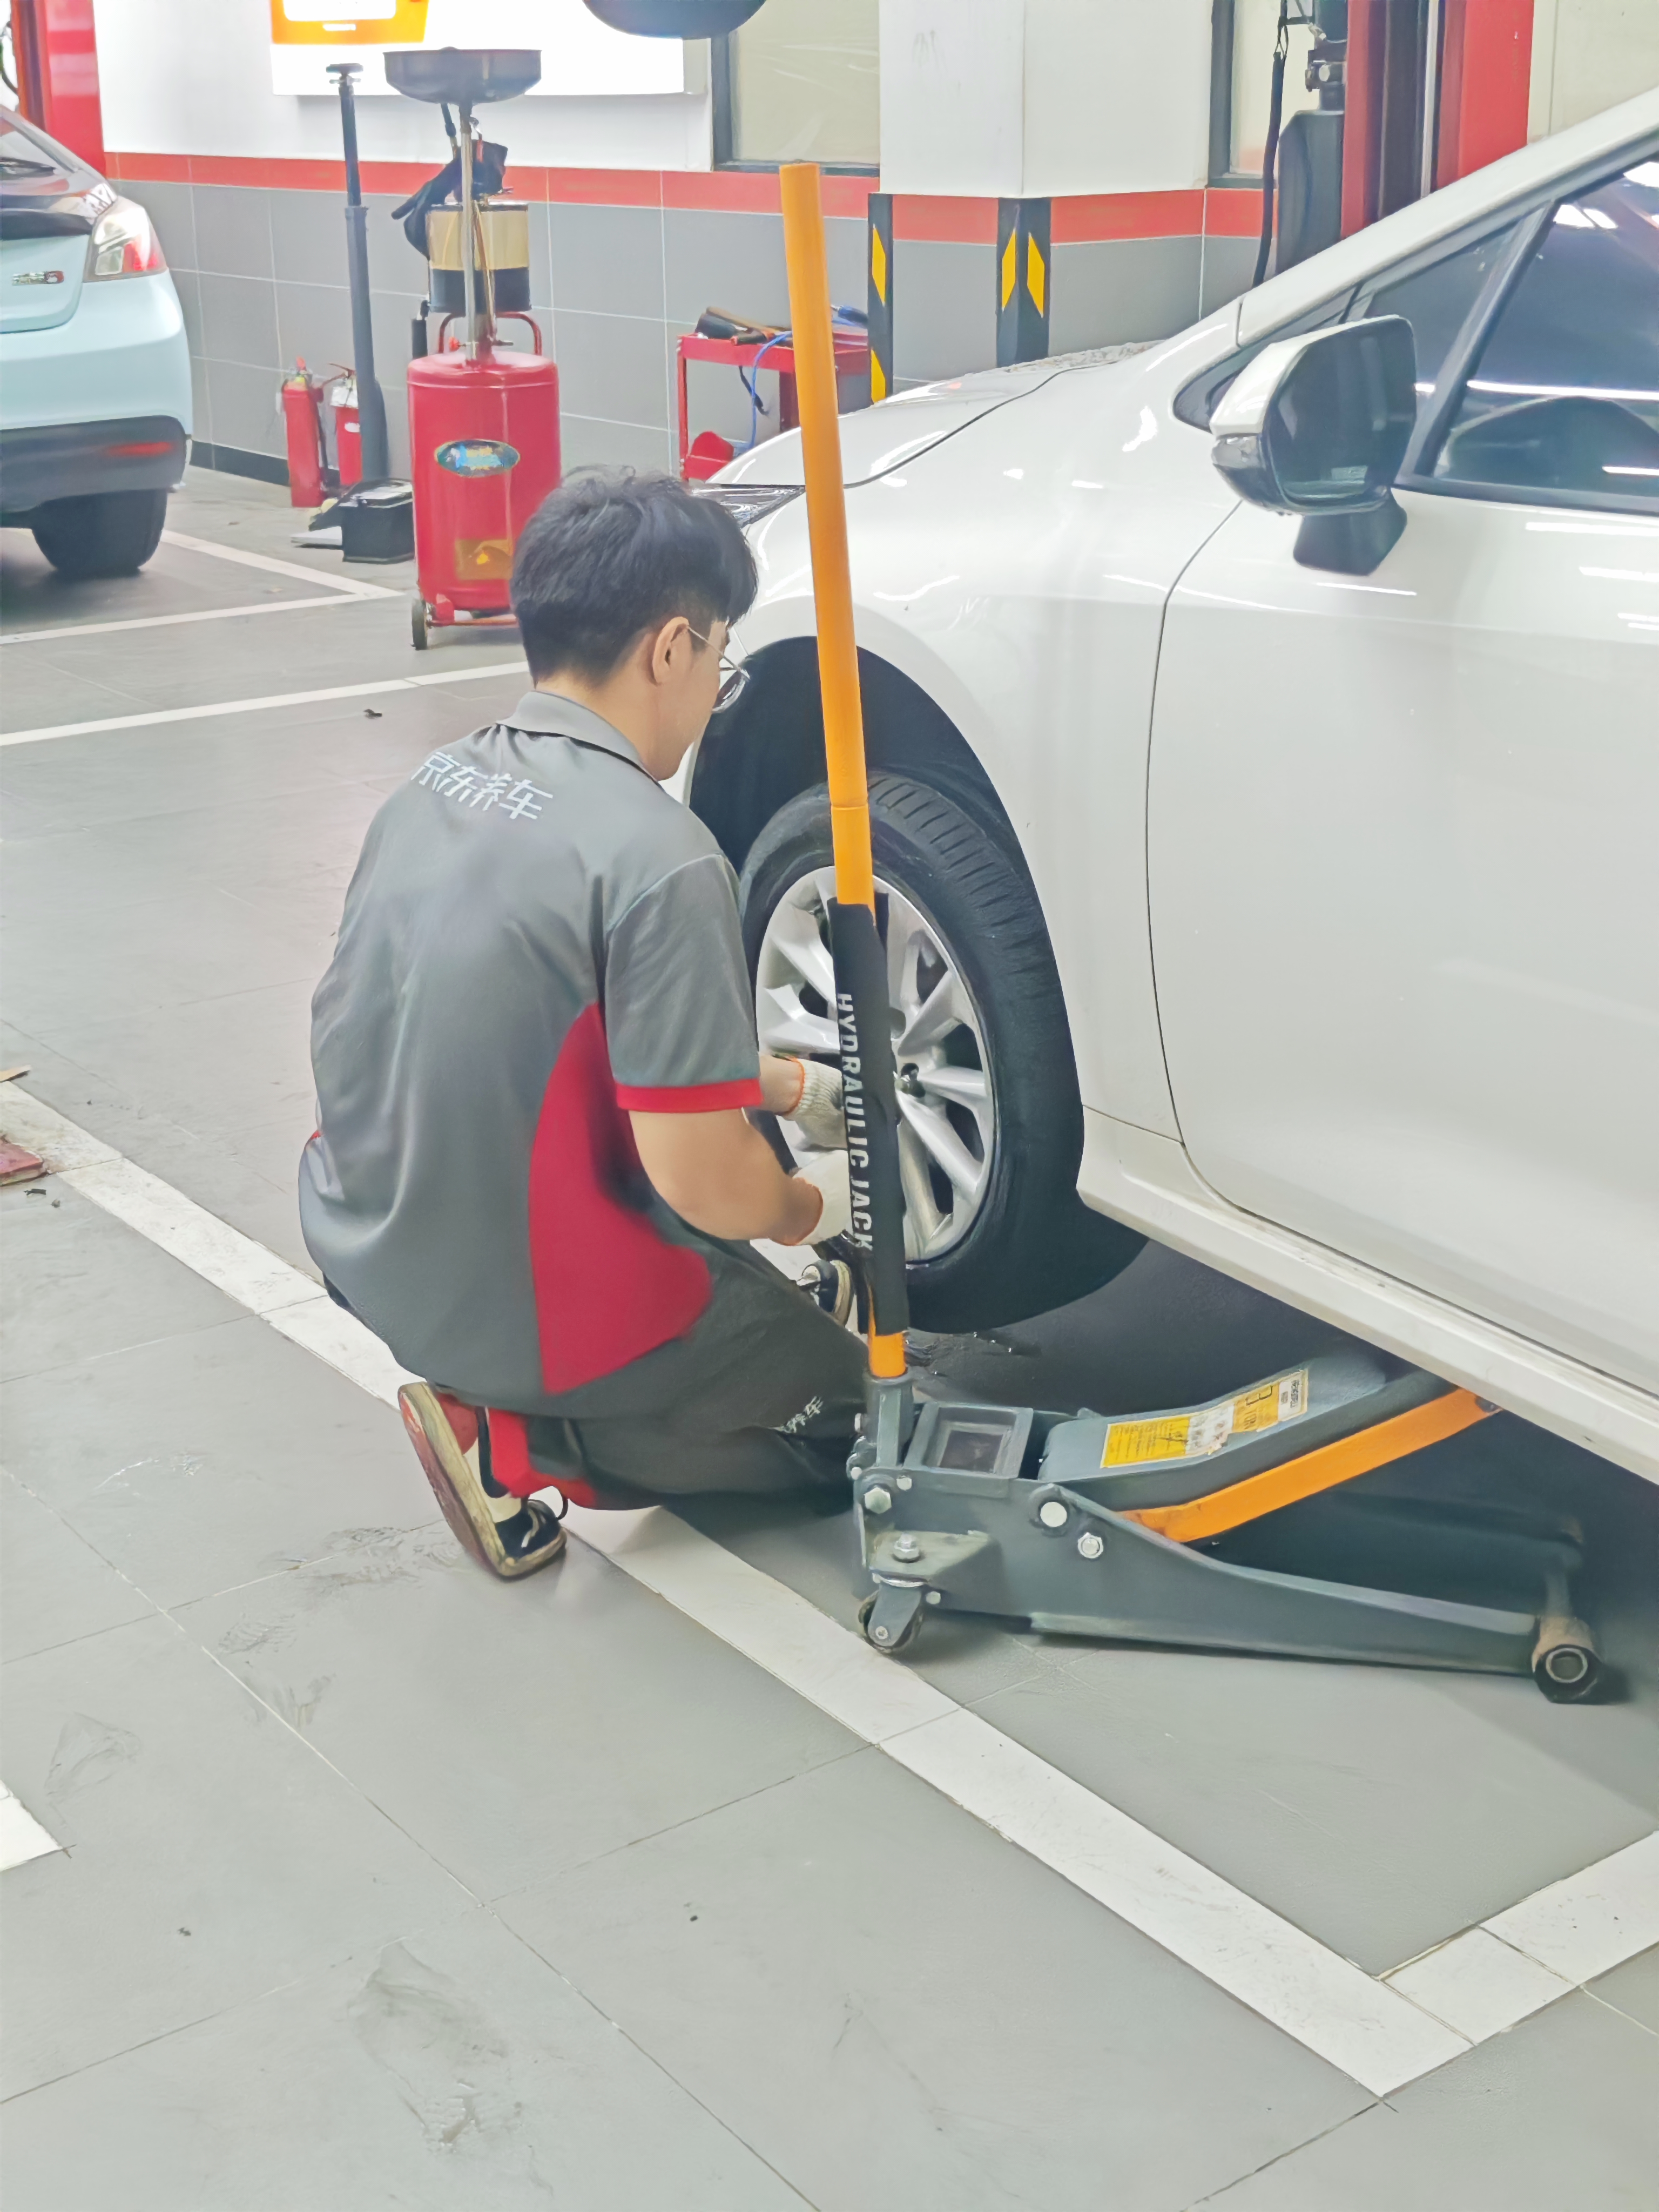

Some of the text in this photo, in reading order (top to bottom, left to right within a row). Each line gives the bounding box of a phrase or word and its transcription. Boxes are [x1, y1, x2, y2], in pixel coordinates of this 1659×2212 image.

[410, 751, 554, 820] 京东养车
[837, 993, 873, 1252] HYDRAULIC JACK
